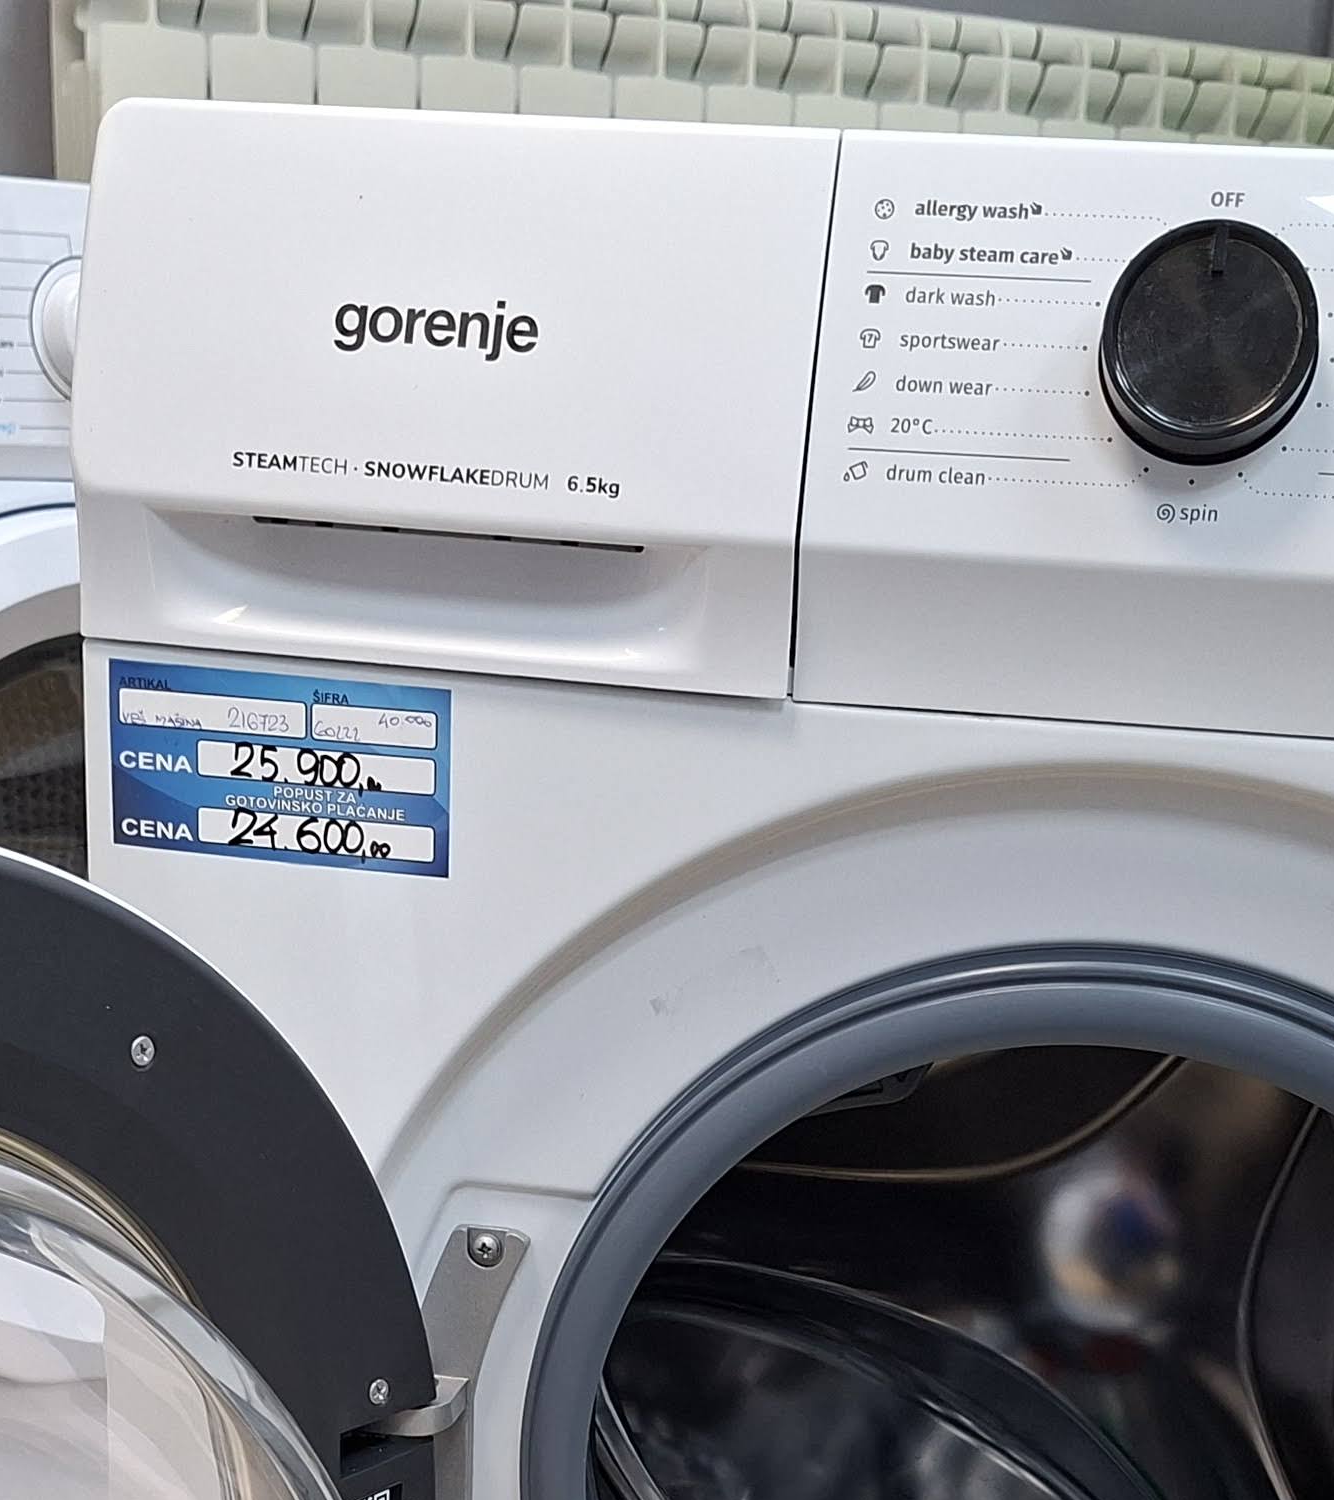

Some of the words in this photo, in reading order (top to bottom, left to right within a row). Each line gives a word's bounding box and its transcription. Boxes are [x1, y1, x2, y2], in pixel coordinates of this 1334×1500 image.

[914, 200, 978, 221] allergy
[983, 203, 1029, 220] wash
[1210, 192, 1245, 208] OFF
[910, 243, 955, 264] baby
[958, 246, 1014, 263] steam
[1019, 250, 1059, 265] care
[905, 286, 946, 305] dark
[950, 289, 996, 306] wash
[334, 300, 539, 361] gorenje
[900, 331, 1000, 352] sportswear
[896, 376, 943, 394] down
[948, 381, 992, 396] wear
[890, 418, 934, 435] 20°C
[232, 451, 348, 476] STEAMTECH
[364, 461, 550, 491] SNOWFLAKEDRUM
[566, 475, 621, 499] 6.5kg
[886, 464, 933, 483] drum
[938, 467, 986, 486] clean
[1179, 506, 1219, 524] spin
[119, 676, 171, 690] ARTIKAL
[313, 689, 349, 704] ŠIFRA
[119, 750, 193, 773] CENA
[273, 786, 333, 803] POPUST
[338, 791, 357, 804] ZA
[225, 794, 323, 815] GOTOVINSKO
[327, 802, 406, 822] PLAĆANJE
[121, 817, 194, 842] CENA
